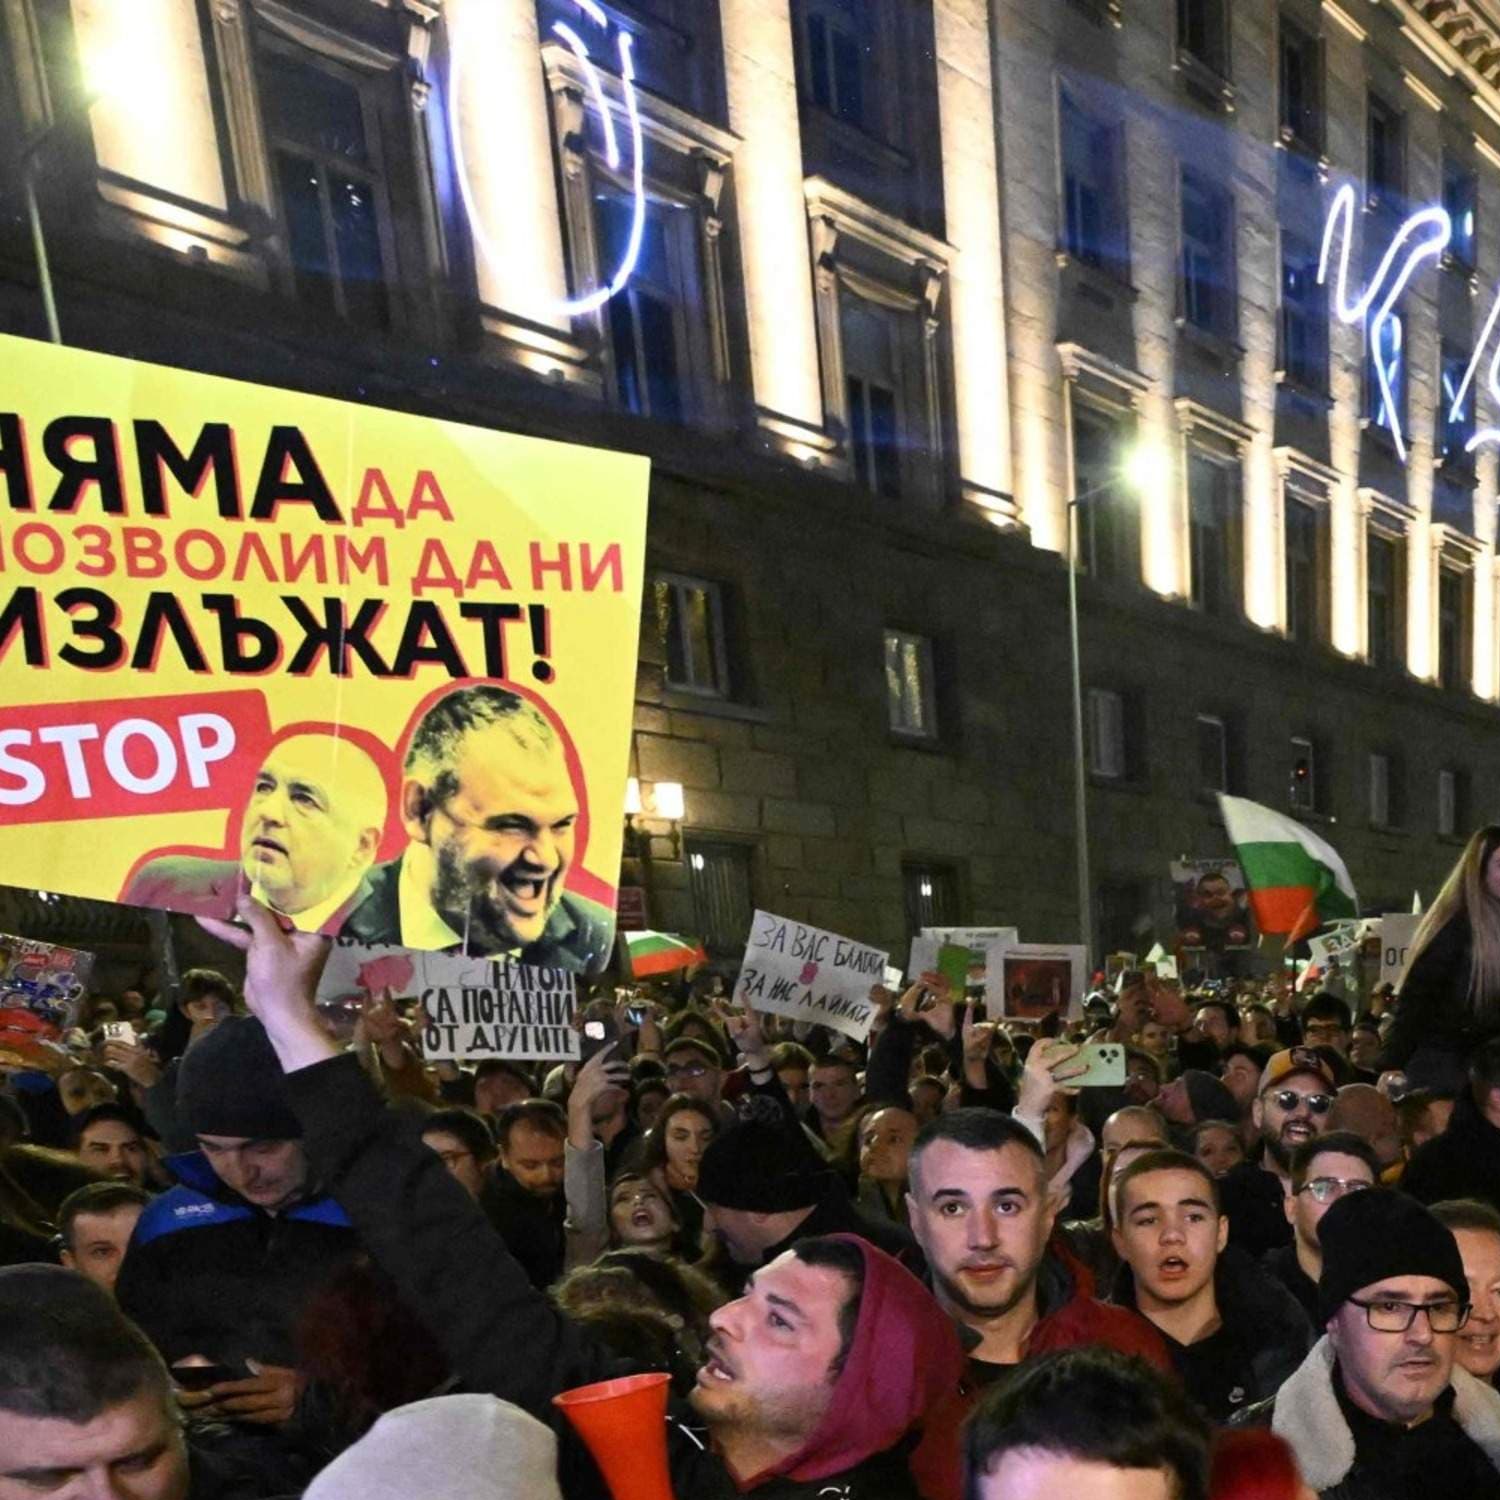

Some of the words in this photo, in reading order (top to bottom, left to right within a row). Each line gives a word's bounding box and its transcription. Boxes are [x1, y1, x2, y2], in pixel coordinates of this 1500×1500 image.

[352, 468, 455, 528] ДА
[0, 521, 389, 587] ОЗВОЛИМ
[411, 538, 512, 598] ДА
[529, 541, 624, 593] НИ
[0, 586, 556, 685] ИЗЛЪЖАТ!
[0, 712, 237, 806] STOP
[753, 914, 787, 953] ЗА
[791, 925, 829, 963] ВАС
[421, 987, 457, 1025] СА
[743, 969, 767, 997] ЗА
[768, 976, 799, 1002] НАС
[425, 1024, 460, 1052] ОТ
[465, 1024, 576, 1055] ДРУГИТЕ
